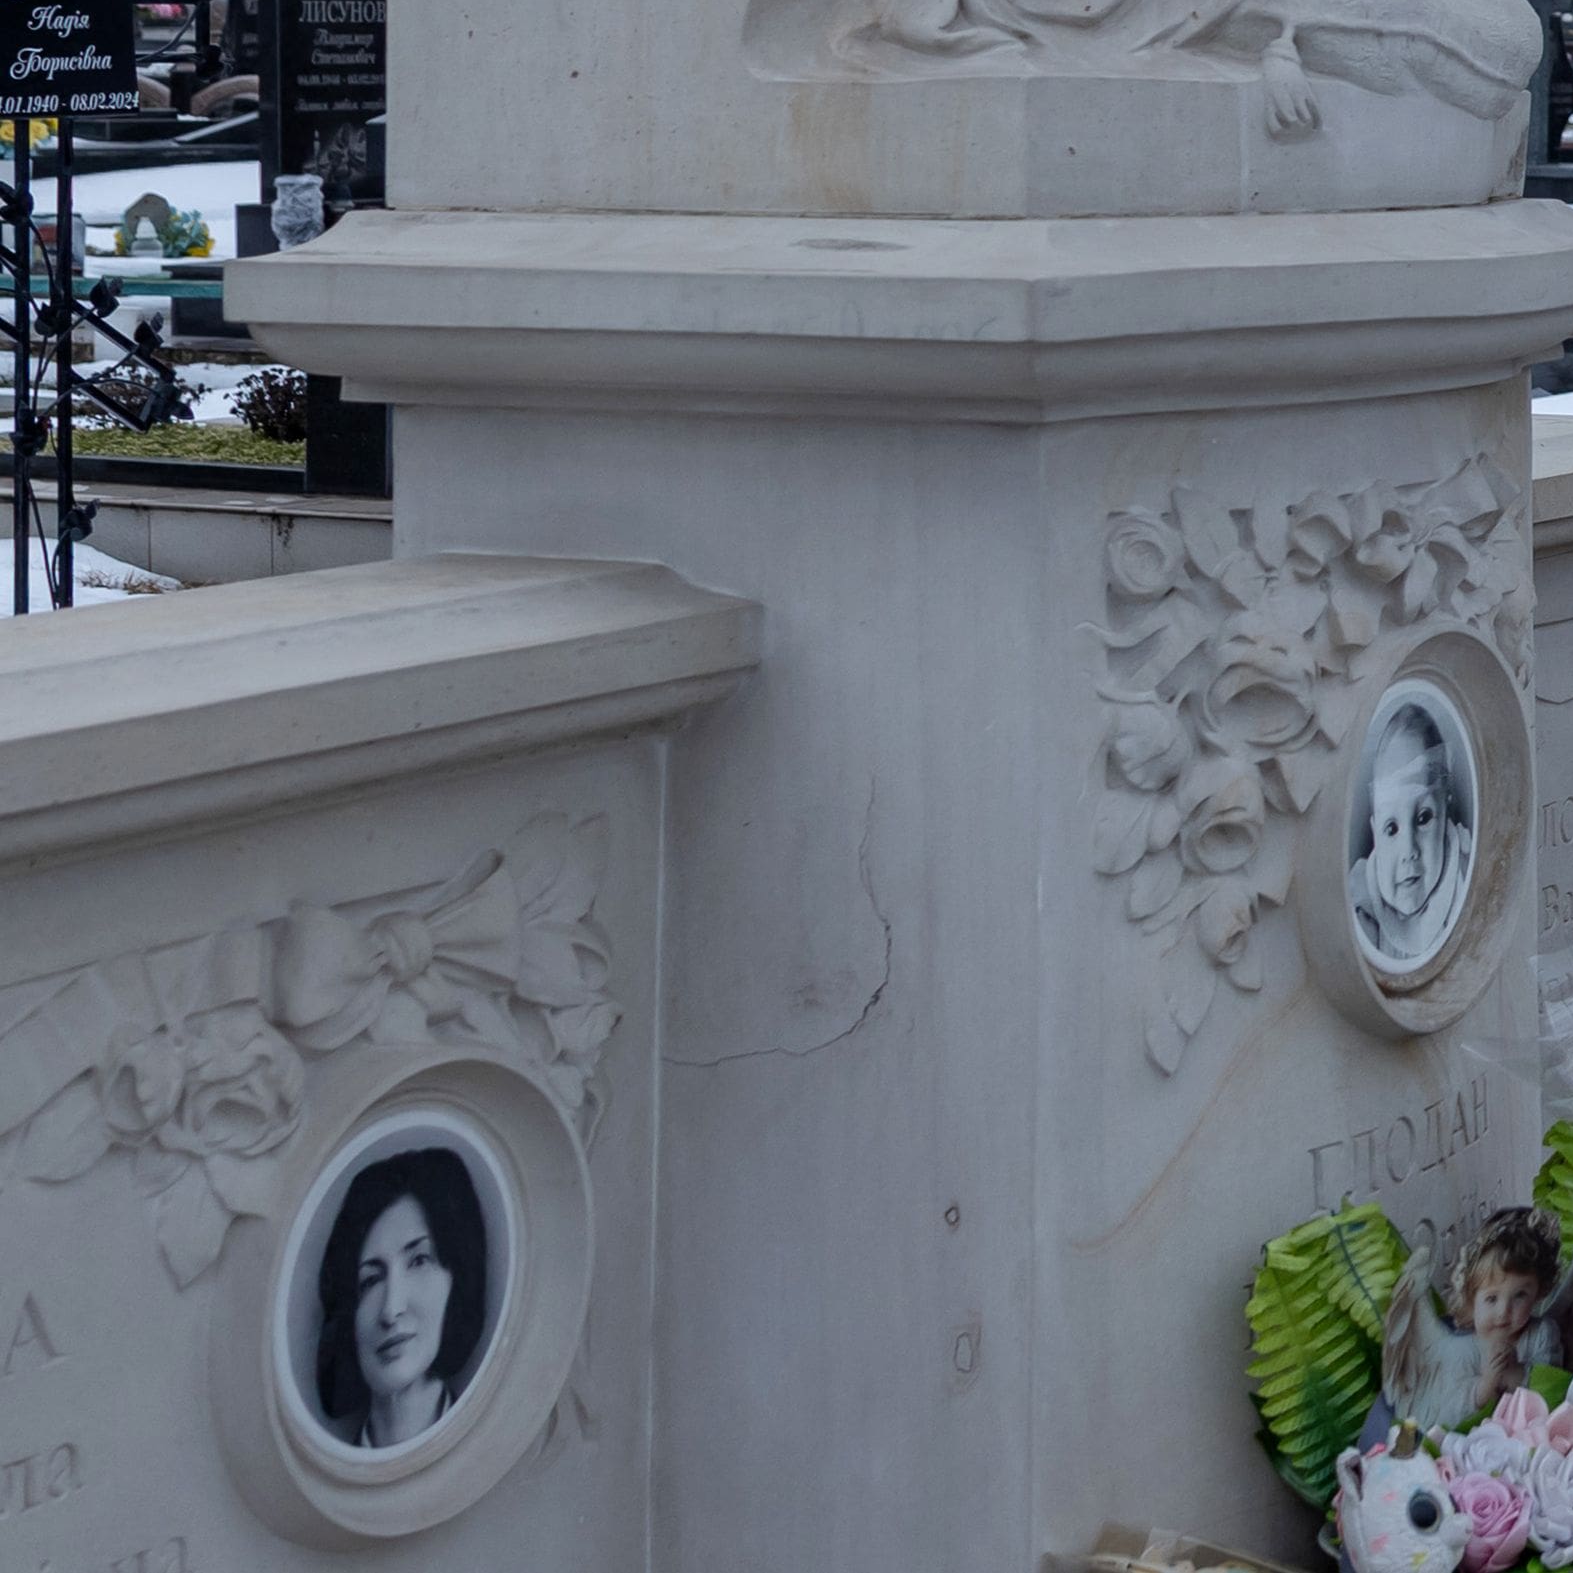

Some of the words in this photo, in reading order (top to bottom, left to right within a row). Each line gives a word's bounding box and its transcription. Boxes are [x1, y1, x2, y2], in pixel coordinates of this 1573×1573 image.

[27, 5, 91, 38] Надія
[10, 44, 113, 80] Борисівна
[0, 95, 59, 114] .01.1940
[70, 91, 140, 112] 08.02.2024
[1307, 1073, 1489, 1212] ГЛОДАН
